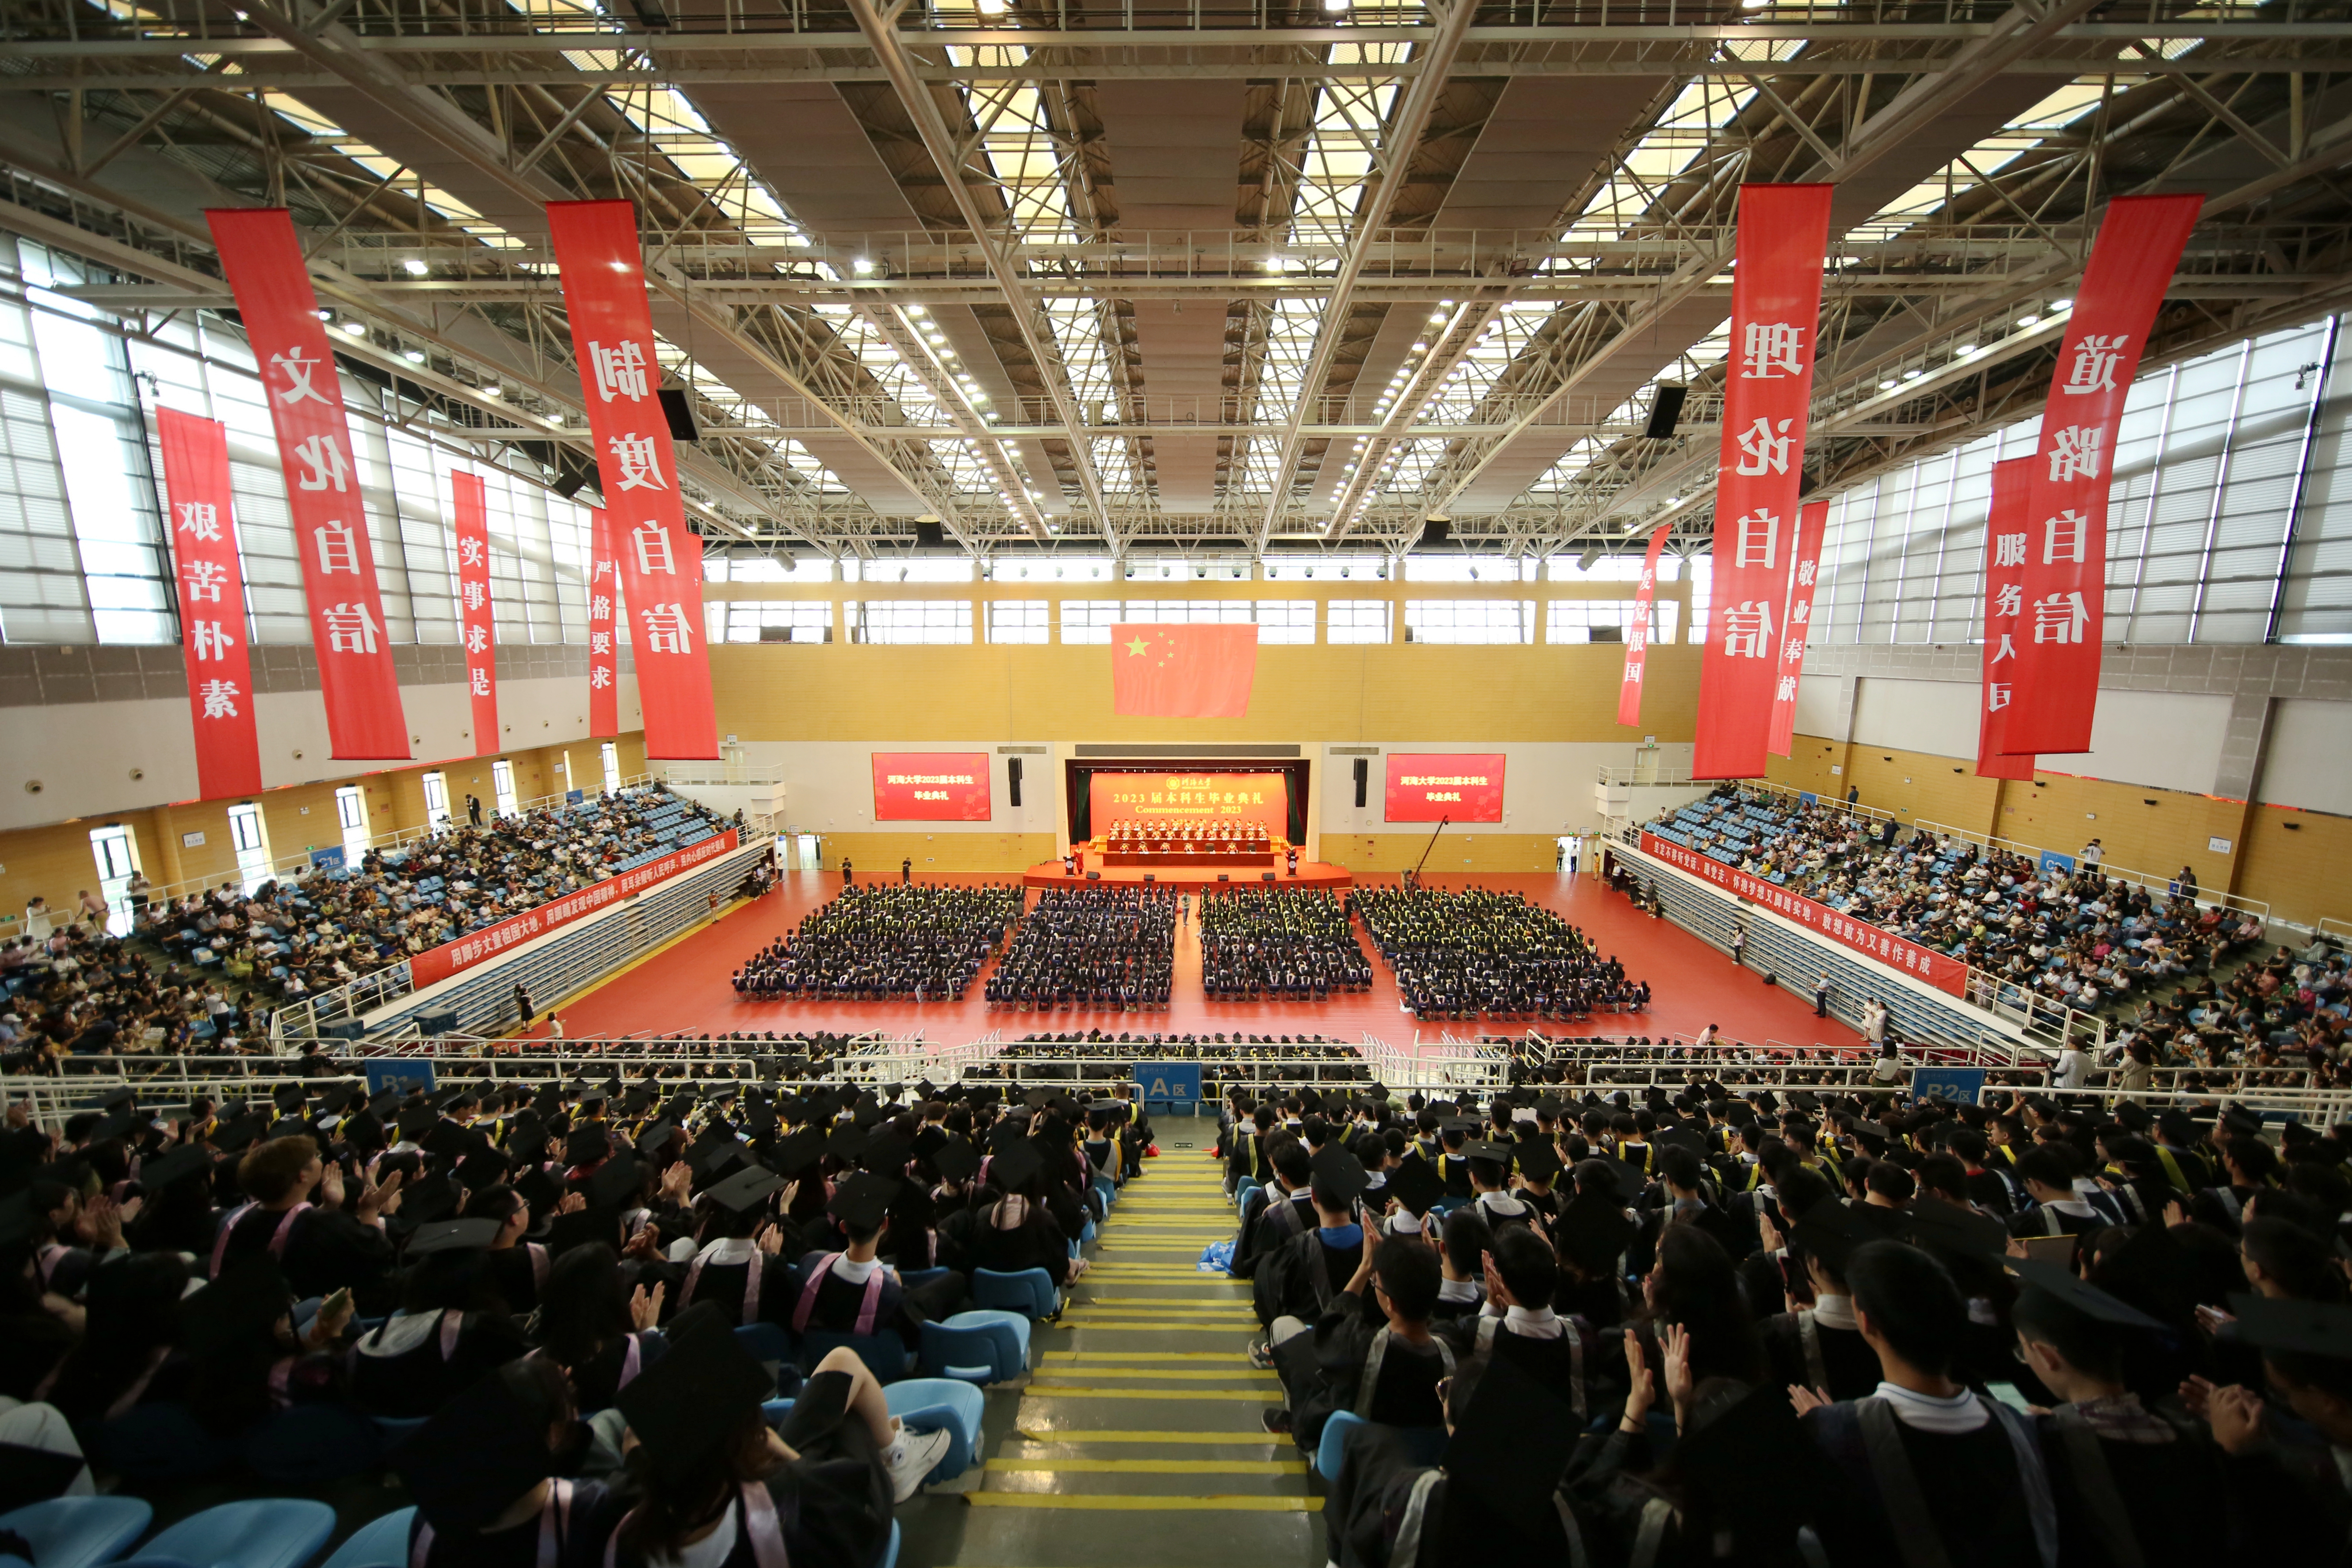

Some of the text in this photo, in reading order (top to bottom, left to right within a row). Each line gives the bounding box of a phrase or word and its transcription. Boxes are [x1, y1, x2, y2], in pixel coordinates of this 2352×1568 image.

[175, 501, 240, 719] 艰苦朴素
[460, 536, 491, 696] 实事求是
[591, 560, 612, 690] 严格要求
[1624, 568, 1653, 683] 爱党报国
[1777, 560, 1817, 702] 敬业奉献
[887, 775, 974, 785] 河海大学2023届本科生
[914, 790, 949, 801] 毕业典礼
[1135, 805, 1242, 814] Commencement 2023
[1400, 776, 1488, 786] 河海大学2023届本科生
[1426, 792, 1462, 802] 毕业典礼
